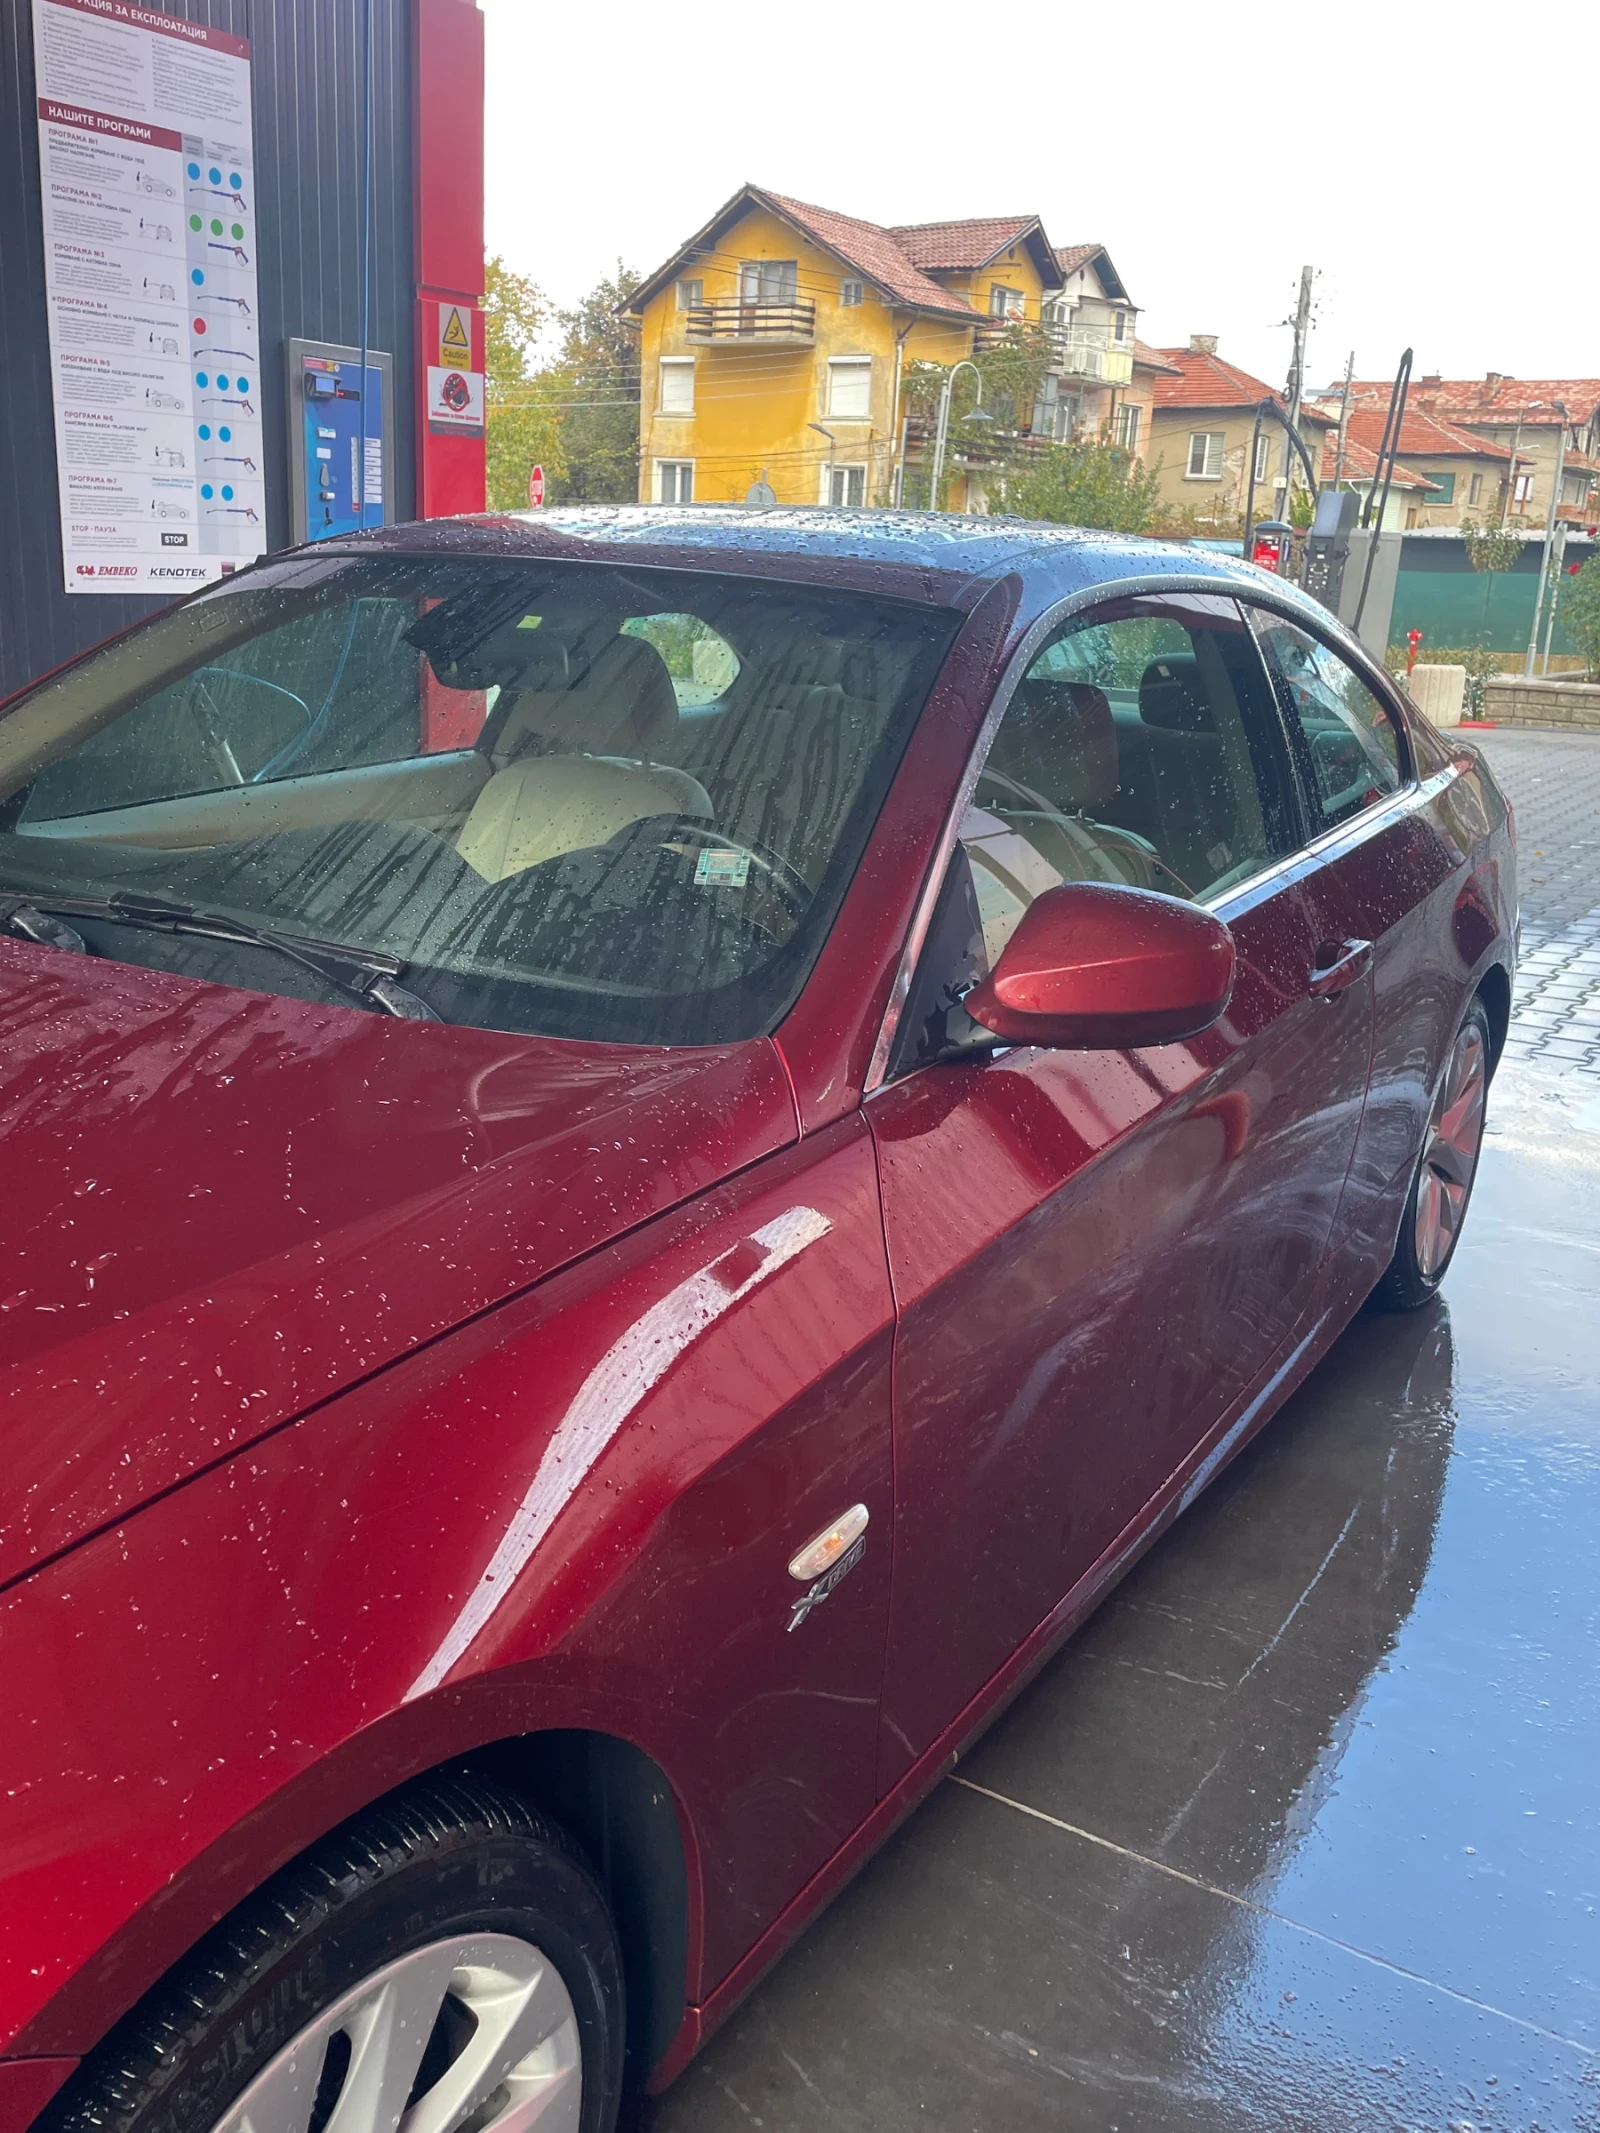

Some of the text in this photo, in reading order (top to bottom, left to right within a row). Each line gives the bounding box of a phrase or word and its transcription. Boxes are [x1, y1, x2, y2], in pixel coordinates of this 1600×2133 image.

[114, 4, 129, 17] ЗА
[131, 10, 207, 41] ЕКСПЛОАТАЦИЯ
[48, 106, 151, 140] НАШИТЕ ПРОГРАМИ
[48, 128, 86, 143] ПРОГРАМА
[51, 184, 102, 200] ПРОГРАМА №2
[54, 243, 92, 256] ПРОГРАМА
[57, 296, 95, 308] ПРОГРАМА
[60, 354, 111, 367] ПРОГРАМА №5
[442, 348, 469, 361] Caution
[64, 410, 101, 420] ПРОГРАМА
[68, 474, 105, 484] ПРОГРАМА
[94, 525, 117, 533] ПАУЗА
[164, 535, 185, 544] STOP
[98, 566, 138, 576] EMBEKO
[150, 568, 207, 577] KENOTEK
